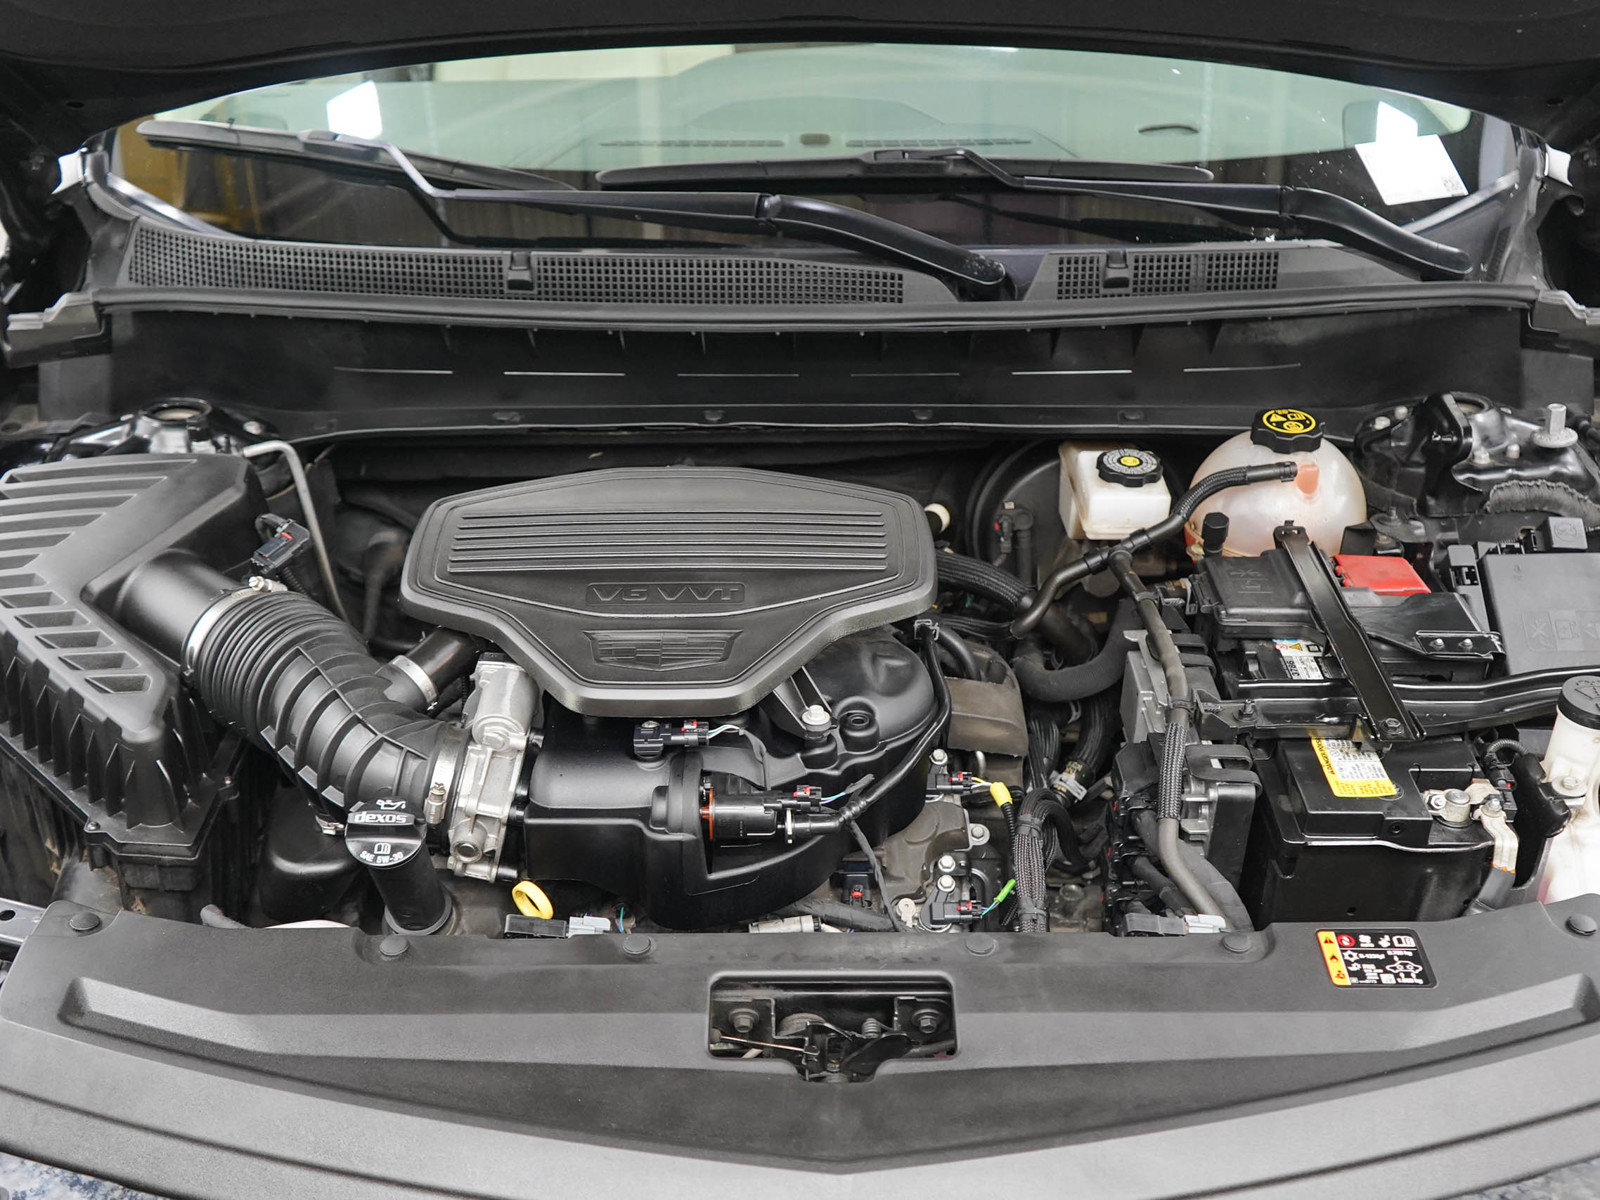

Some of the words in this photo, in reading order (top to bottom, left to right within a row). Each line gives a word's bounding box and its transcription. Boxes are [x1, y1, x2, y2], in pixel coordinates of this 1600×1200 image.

[593, 587, 648, 601] V6
[657, 586, 740, 601] VVT
[354, 811, 408, 824] dexos
[360, 850, 375, 862] SAE
[376, 851, 404, 864] 5W-30
